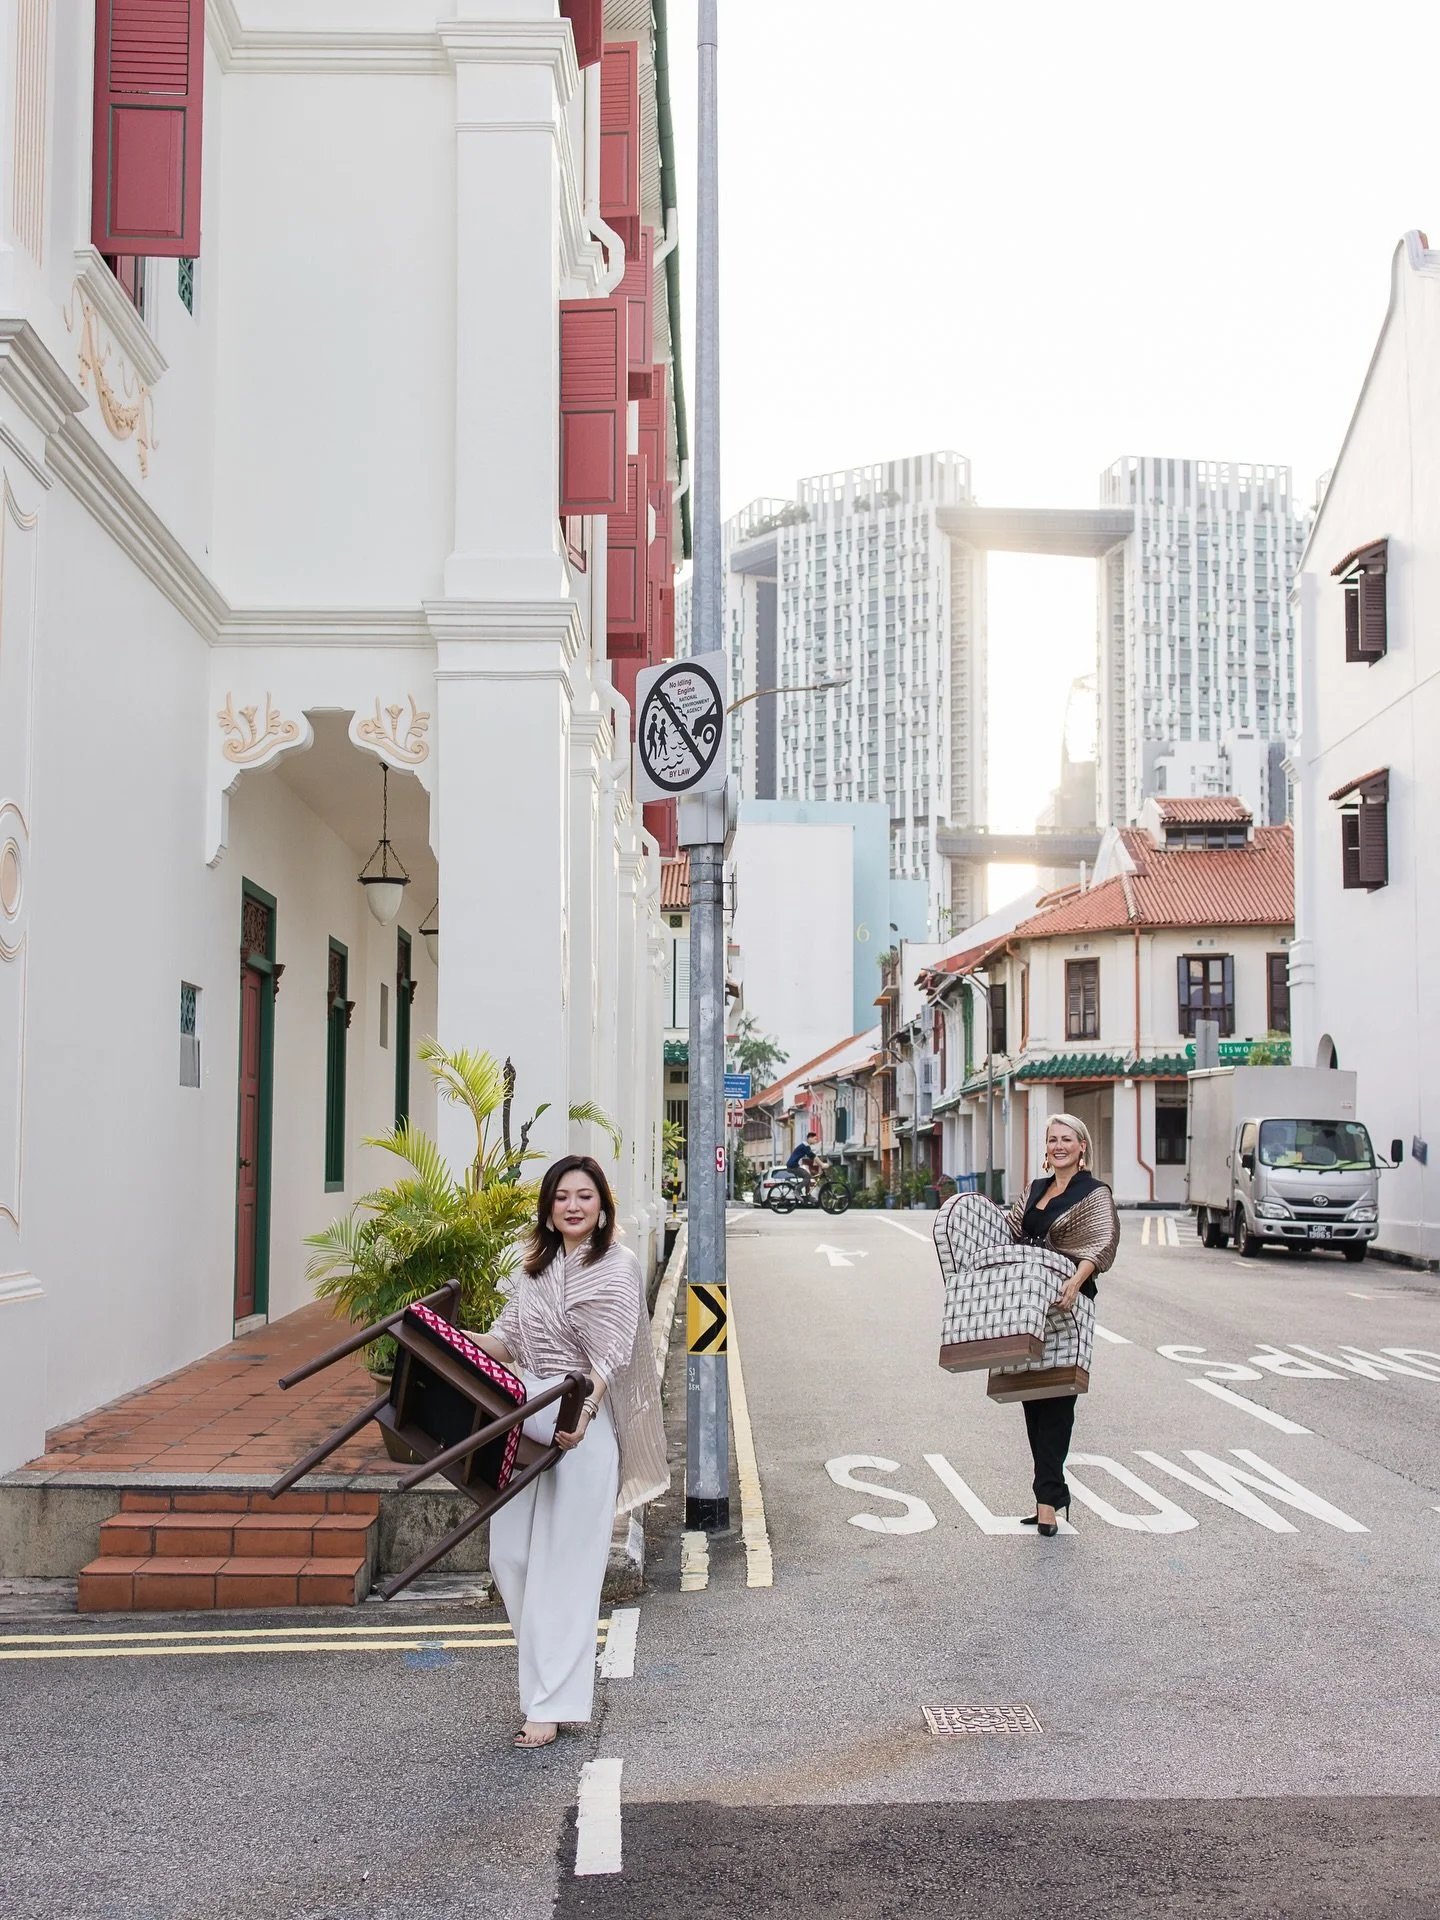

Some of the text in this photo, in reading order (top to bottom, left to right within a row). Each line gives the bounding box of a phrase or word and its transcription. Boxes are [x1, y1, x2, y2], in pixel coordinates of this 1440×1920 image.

[677, 679, 692, 687] Idling
[677, 687, 695, 695] Engine
[679, 694, 698, 702] NATIONAL
[682, 698, 710, 708] ENVIRONMENT
[686, 706, 703, 714] AGENCY
[669, 768, 690, 778] BY LAW
[856, 922, 870, 943] 6
[716, 1147, 725, 1172] 9
[824, 1450, 1371, 1536] SLOW
